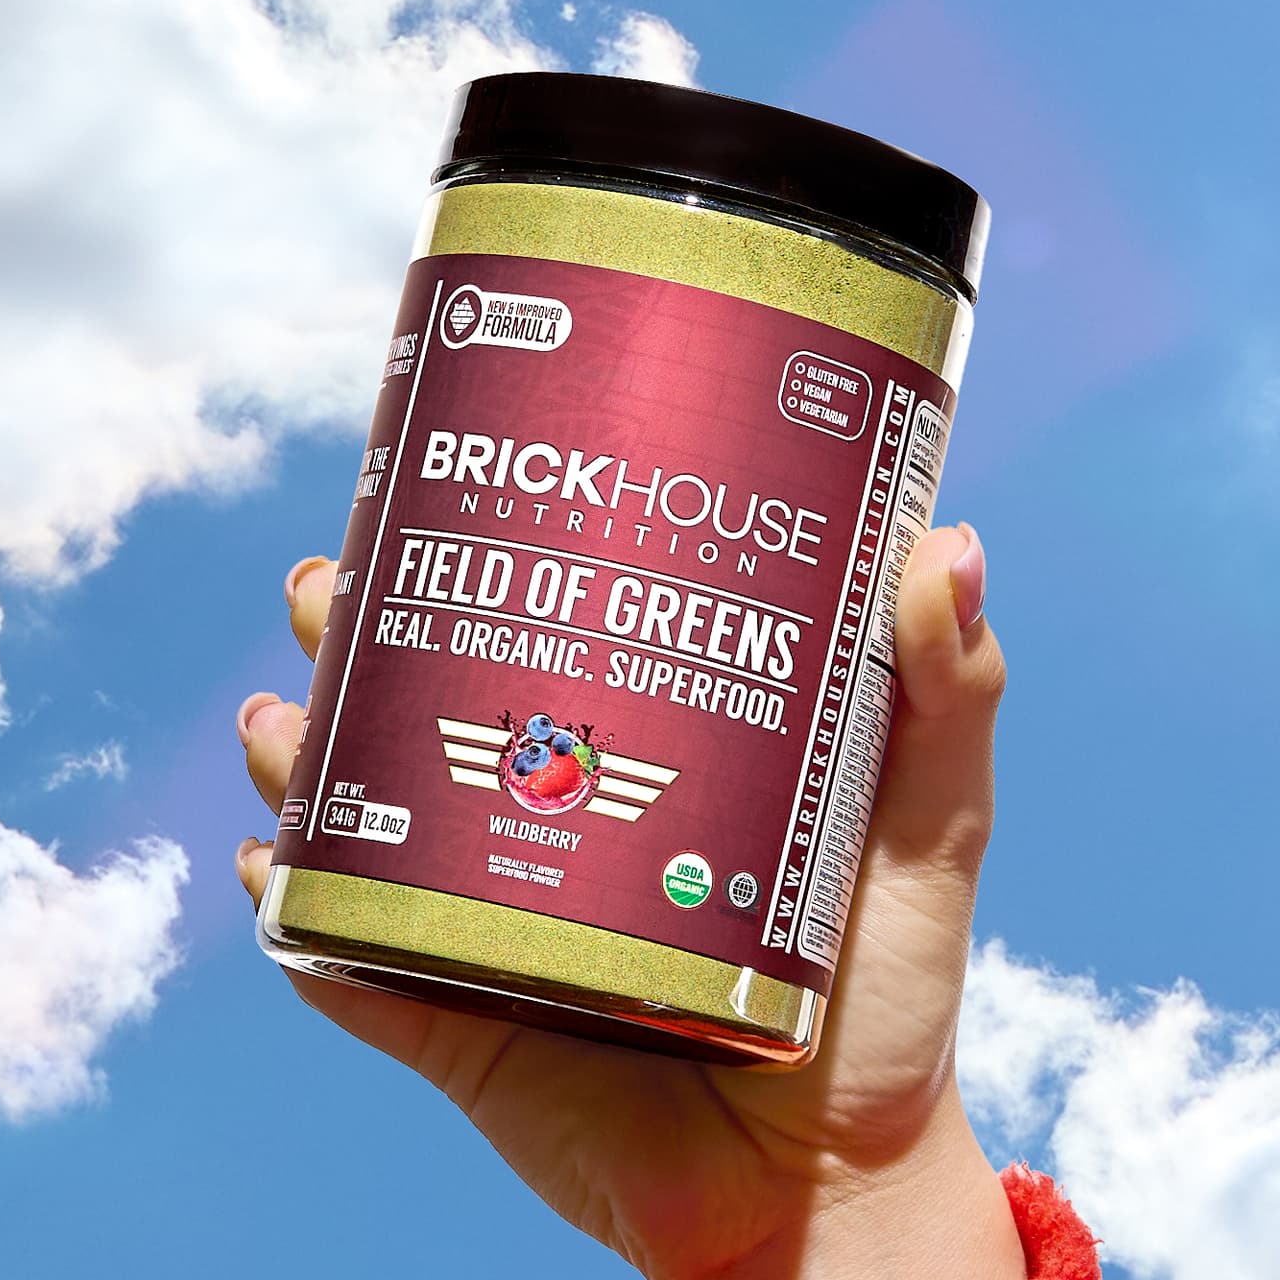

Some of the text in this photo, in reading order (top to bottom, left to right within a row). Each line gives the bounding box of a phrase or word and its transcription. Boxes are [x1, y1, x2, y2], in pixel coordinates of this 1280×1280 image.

[488, 300, 563, 321] NEW & IMPROVED
[482, 314, 557, 345] FORMULA
[803, 382, 832, 403] VEGAN
[806, 365, 859, 395] GLUTEN FREE
[800, 399, 849, 428] VEGETARIAN
[371, 446, 391, 471] THE
[420, 430, 828, 566] BRICKHOUSE
[460, 492, 758, 577] NUTRITION
[393, 538, 801, 681] FIELD OF GREENS
[375, 609, 788, 735] REAL. ORGANIC. SUPERFOOD.
[770, 385, 910, 948] WWW.BRICKHOUSENUTRITION.COM
[333, 781, 366, 799] NET WT.
[329, 806, 357, 827] 341G
[489, 814, 582, 852] WILDBERRY
[487, 863, 561, 888] SUPERFOOD POWDER
[488, 854, 565, 879] NATURALLY FLAVORED
[676, 863, 705, 881] USDA
[668, 878, 705, 897] ORGANIC
